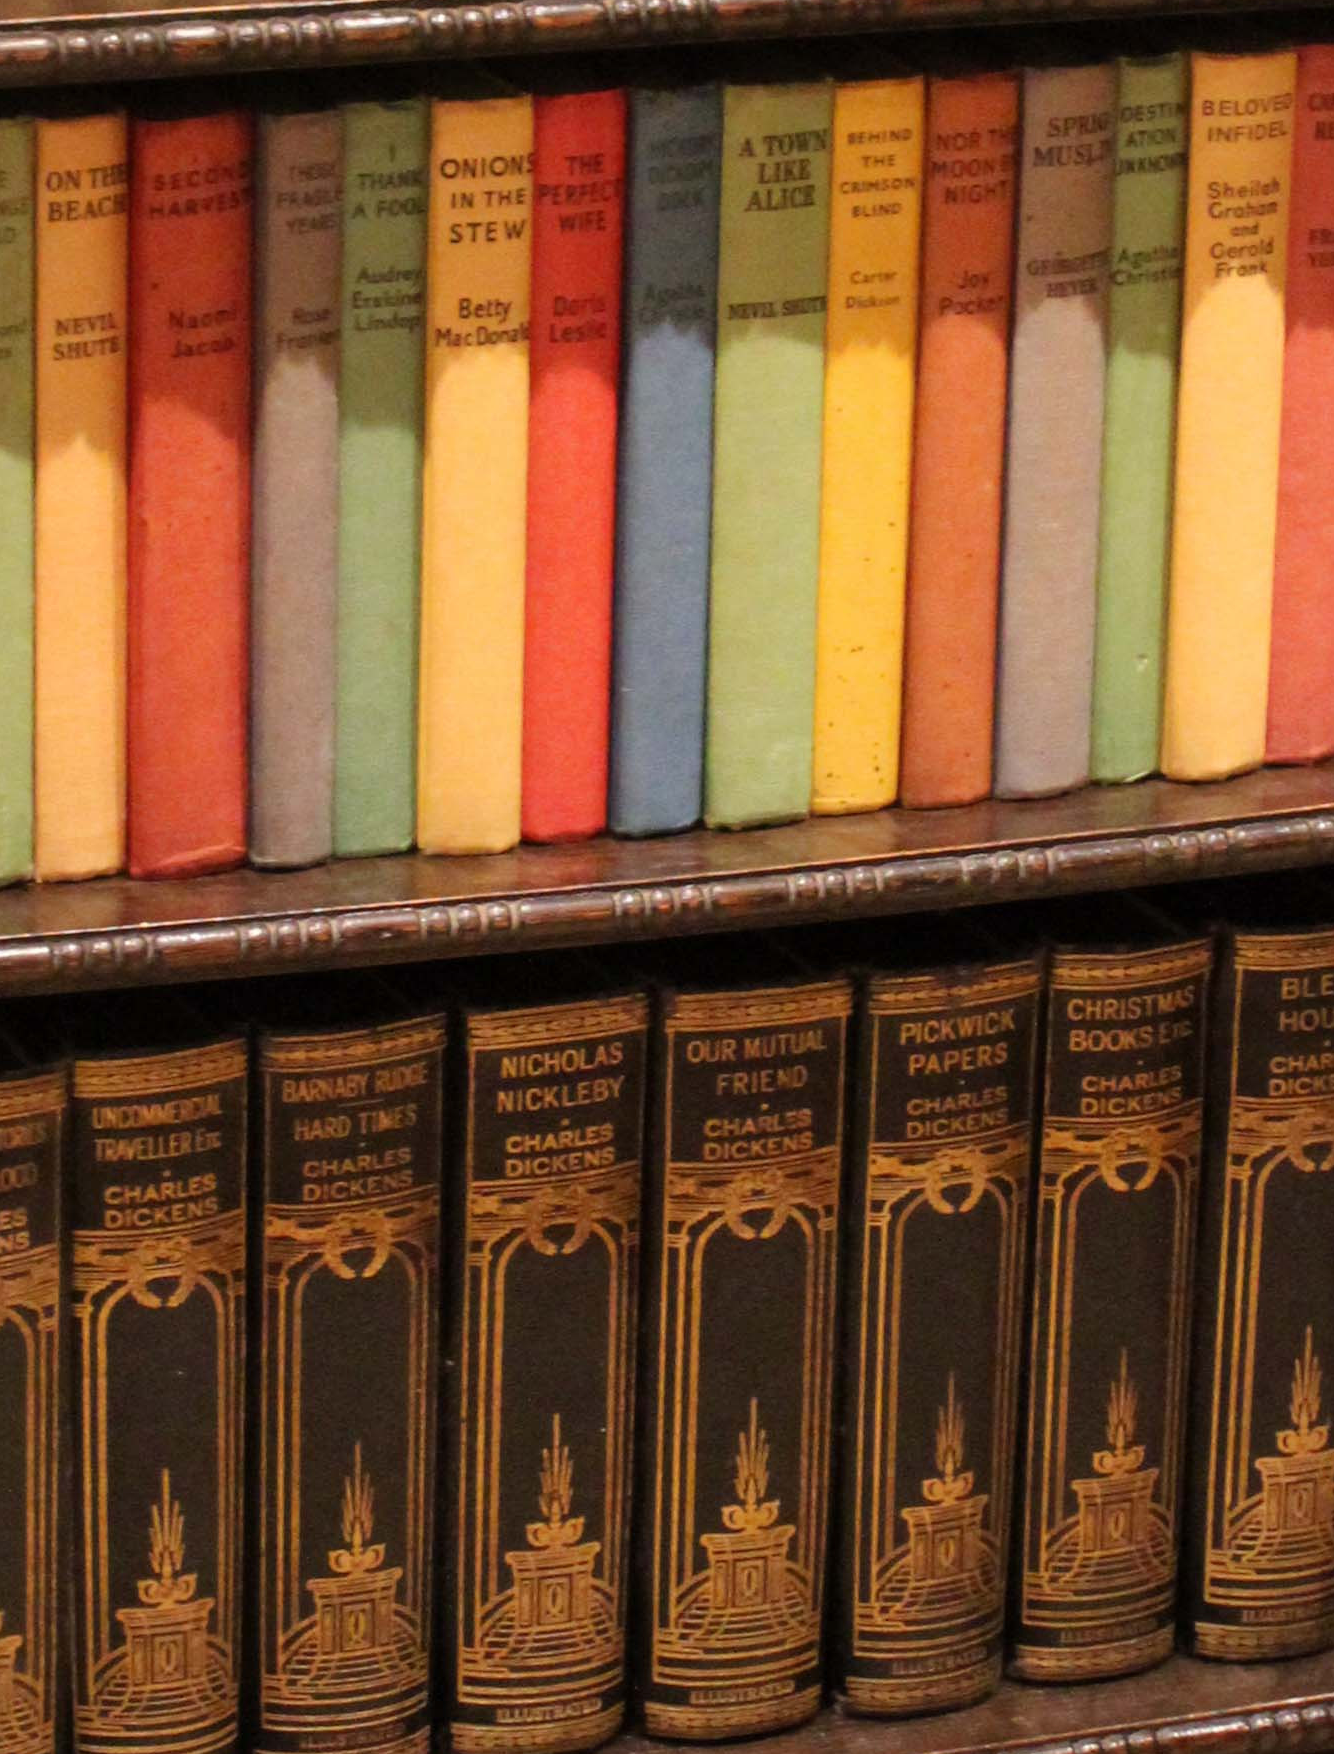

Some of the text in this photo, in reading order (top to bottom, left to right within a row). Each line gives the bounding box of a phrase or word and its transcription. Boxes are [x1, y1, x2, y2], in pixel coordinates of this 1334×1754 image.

[1202, 93, 1293, 116] BELOVED
[739, 128, 830, 158] A TOWN
[847, 128, 914, 145] BEHIND
[1208, 120, 1290, 142] INFIDEL
[440, 152, 536, 179] ONIONS
[565, 153, 605, 176] THE
[757, 158, 812, 185] LIKE
[861, 154, 896, 167] THE
[45, 162, 128, 192] ON THE
[840, 177, 916, 195] CRIMSON
[352, 201, 366, 219] A
[451, 188, 526, 209] IN THE
[744, 184, 816, 212] ALICE
[852, 202, 903, 218] BLIND
[449, 219, 529, 244] STEW
[558, 210, 607, 234] WIFE
[1229, 223, 1259, 237] and
[1215, 260, 1268, 279] Frank
[459, 298, 514, 324] Betty
[52, 335, 123, 361] SHUTE
[1067, 985, 1195, 1022] CHRISTMAS
[900, 1009, 1015, 1046] PICKWICK
[1069, 1026, 1154, 1053] BOOKS
[500, 1042, 624, 1079] NICHOLAS
[686, 1030, 827, 1064] OUR MUTUAL
[909, 1042, 1008, 1076] PAPERS
[282, 1062, 428, 1103] BARNABY RUDGE
[716, 1065, 809, 1096] FRIEND
[1082, 1065, 1182, 1093] CHARLES
[496, 1074, 625, 1114] NICKLEBY
[907, 1086, 1008, 1116] CHARLES
[1081, 1087, 1182, 1116] DICKENS
[294, 1104, 417, 1142] HARD TIMES
[703, 1109, 812, 1138] CHARLES
[907, 1108, 1008, 1139] DICKENS
[94, 1133, 193, 1162] TRAVELLER
[505, 1122, 614, 1155] CHARLES
[703, 1131, 813, 1161] DICKENS
[303, 1147, 412, 1178] CHARLES
[505, 1145, 616, 1178] DICKENS
[104, 1173, 217, 1205] CHARLES
[303, 1169, 414, 1202] DICKENS
[104, 1196, 218, 1228] DICKENS
